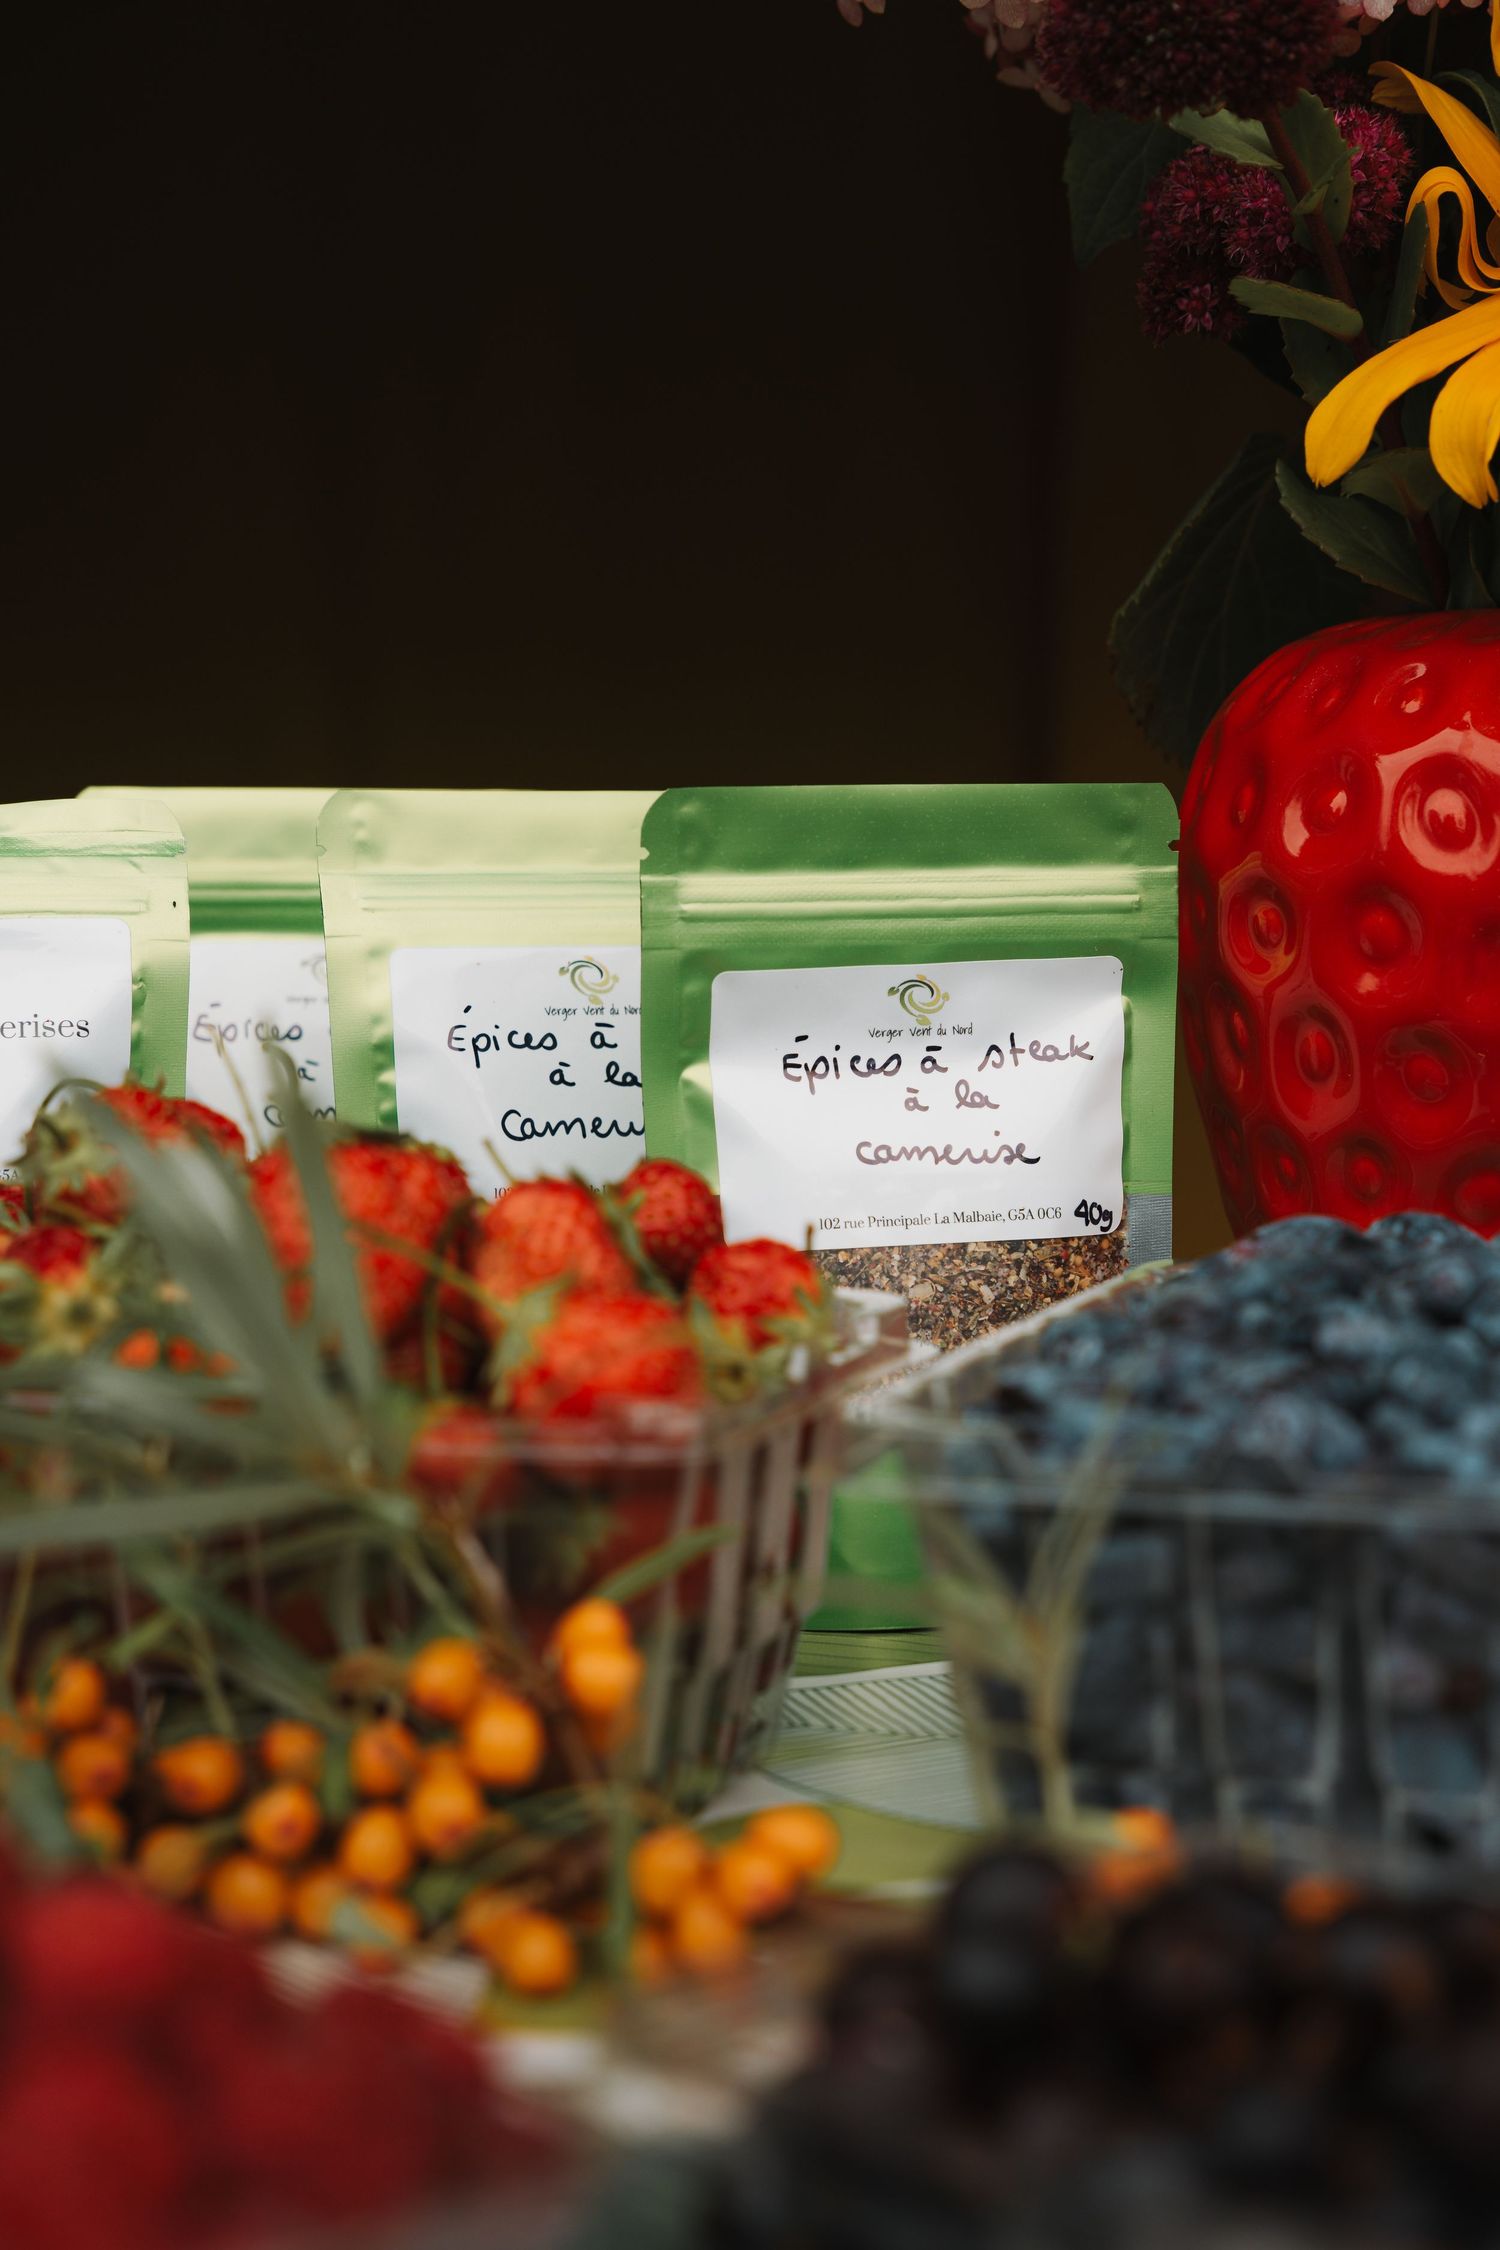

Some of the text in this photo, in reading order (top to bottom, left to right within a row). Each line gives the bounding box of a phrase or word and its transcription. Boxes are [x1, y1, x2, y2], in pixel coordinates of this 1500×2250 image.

[544, 1006, 577, 1021] Verger
[583, 1006, 604, 1015] Vent
[610, 1004, 619, 1015] du
[447, 1005, 558, 1068] Épices
[868, 1022, 973, 1043] Verger Vent du Nord
[604, 1060, 643, 1088] la
[783, 1035, 902, 1095] Épices
[977, 1032, 1095, 1072] steak
[954, 1079, 1000, 1109] la
[819, 1206, 1062, 1231] 102 rue Principale La Malbaie, G5A 0C6
[1074, 1199, 1114, 1233] 40g
